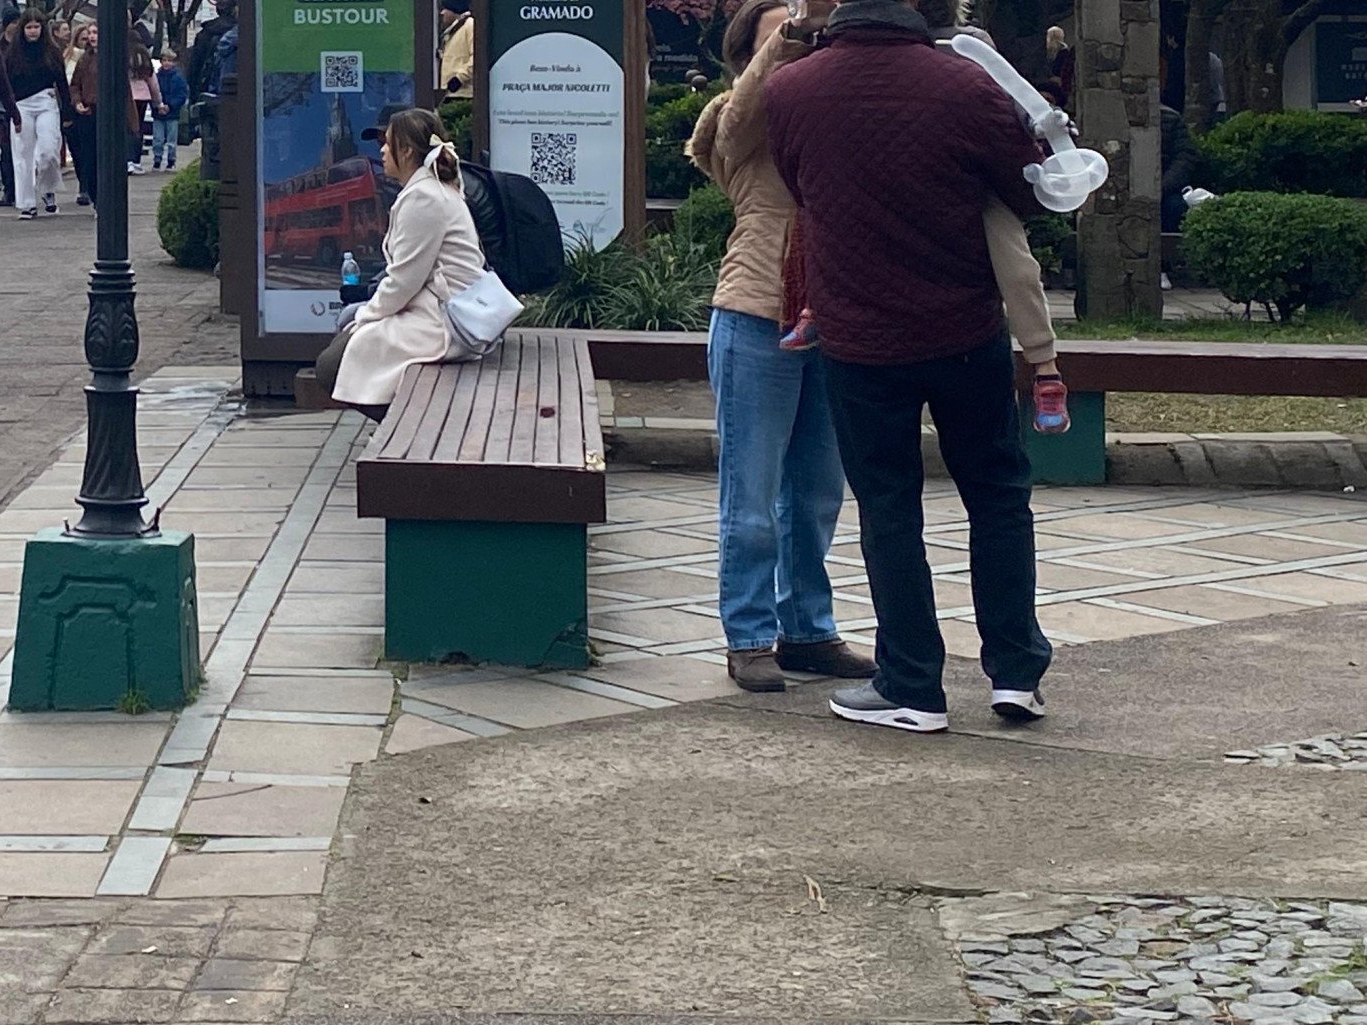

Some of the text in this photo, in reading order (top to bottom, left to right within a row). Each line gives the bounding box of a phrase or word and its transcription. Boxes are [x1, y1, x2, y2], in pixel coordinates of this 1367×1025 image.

[293, 7, 390, 25] BUSTOUR
[519, 5, 594, 20] GRAMADO
[502, 83, 611, 94] PRAÇA MAJOR NICOLETTI
